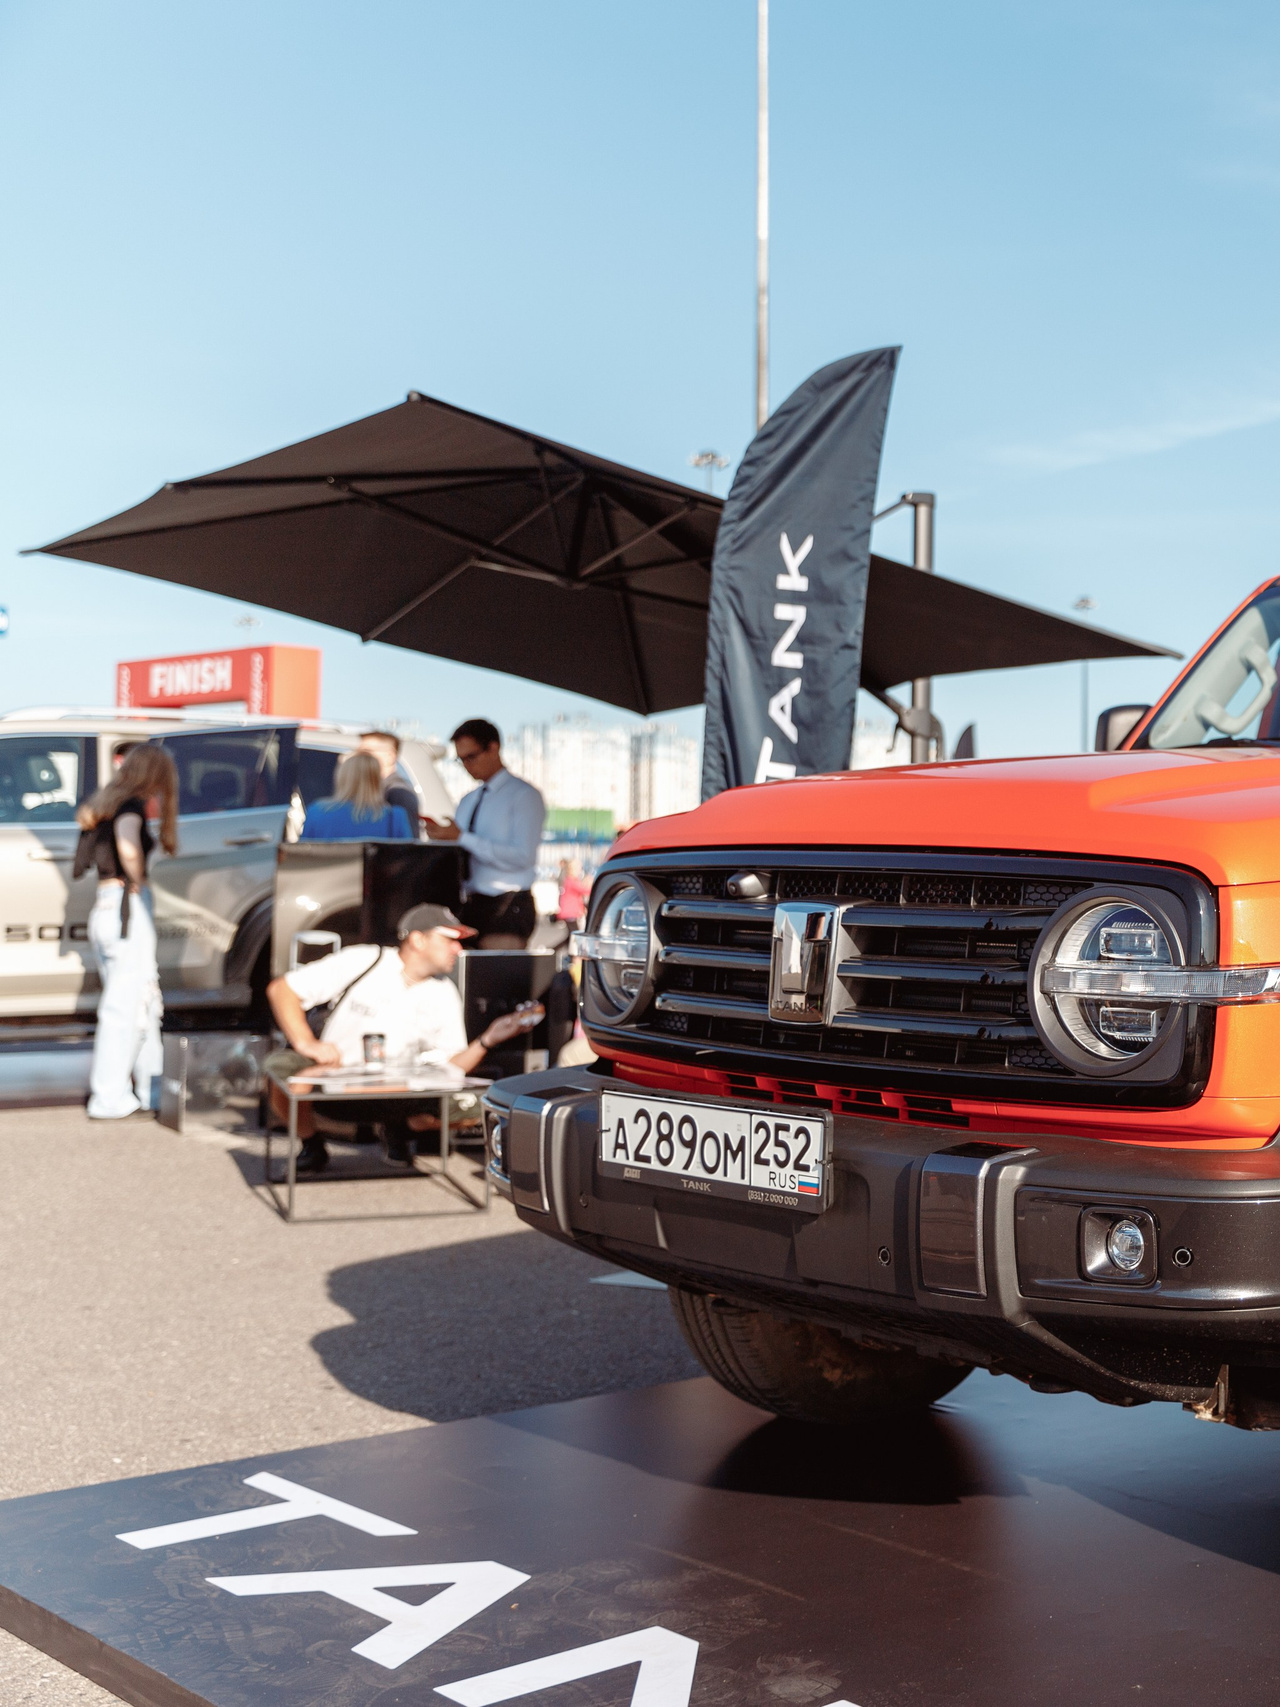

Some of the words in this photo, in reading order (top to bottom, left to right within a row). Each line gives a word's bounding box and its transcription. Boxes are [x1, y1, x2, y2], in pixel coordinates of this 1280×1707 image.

[754, 531, 814, 784] TANK
[150, 656, 233, 698] FINISH
[775, 1000, 816, 1014] TANK
[753, 1120, 812, 1173] 252
[680, 1178, 712, 1193] TANK
[768, 1171, 797, 1190] RUS
[747, 1189, 764, 1203] (831)
[764, 1192, 770, 1202] 2
[769, 1193, 784, 1204] 000
[783, 1195, 798, 1207] 000
